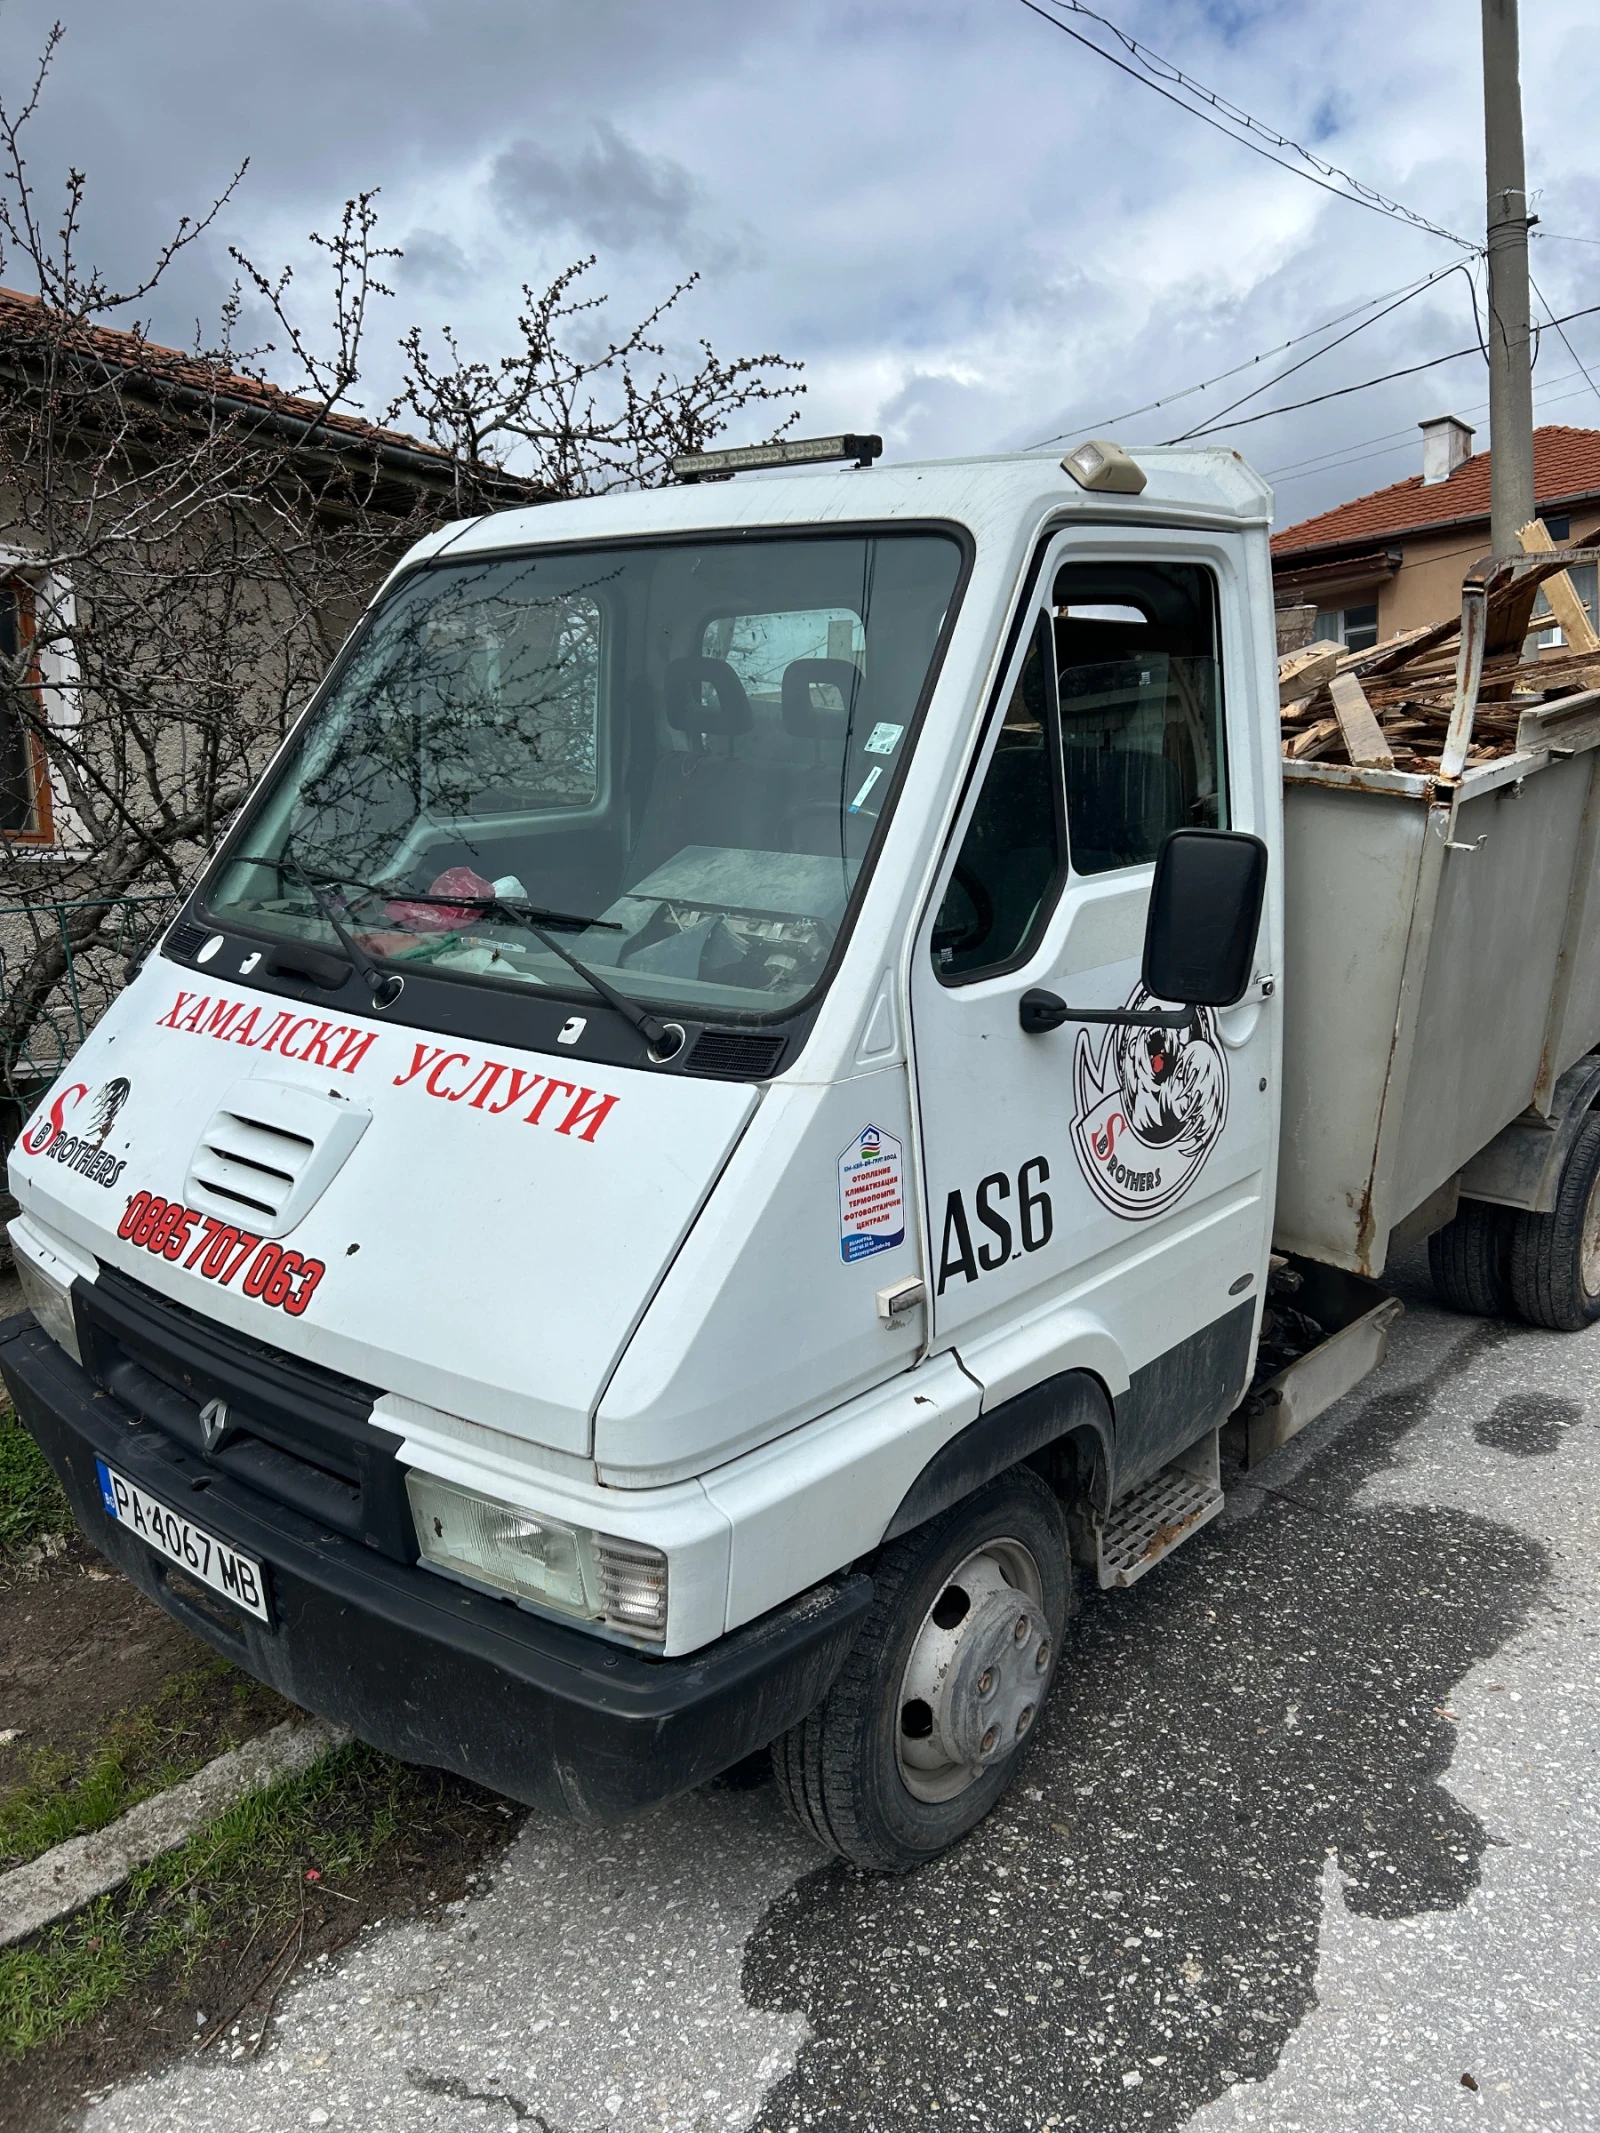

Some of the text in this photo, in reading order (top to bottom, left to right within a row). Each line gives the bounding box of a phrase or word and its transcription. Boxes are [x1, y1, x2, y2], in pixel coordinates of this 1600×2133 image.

[156, 991, 621, 1144] ХАМАЛСКИ УСЛУГИ
[852, 1166, 891, 1183] ОТОПЛЕНИЕ
[845, 1176, 898, 1197] КЛИМАТИЗАЦИЯ
[848, 1188, 896, 1208] ТЕРМОПОМПИ
[843, 1198, 901, 1221] ФОТОВОЛТАИЧНИ
[856, 1213, 890, 1230] ЦЕНТРАЛИ
[117, 1190, 326, 1316] 0885 707 063
[152, 1505, 212, 1576] 4067
